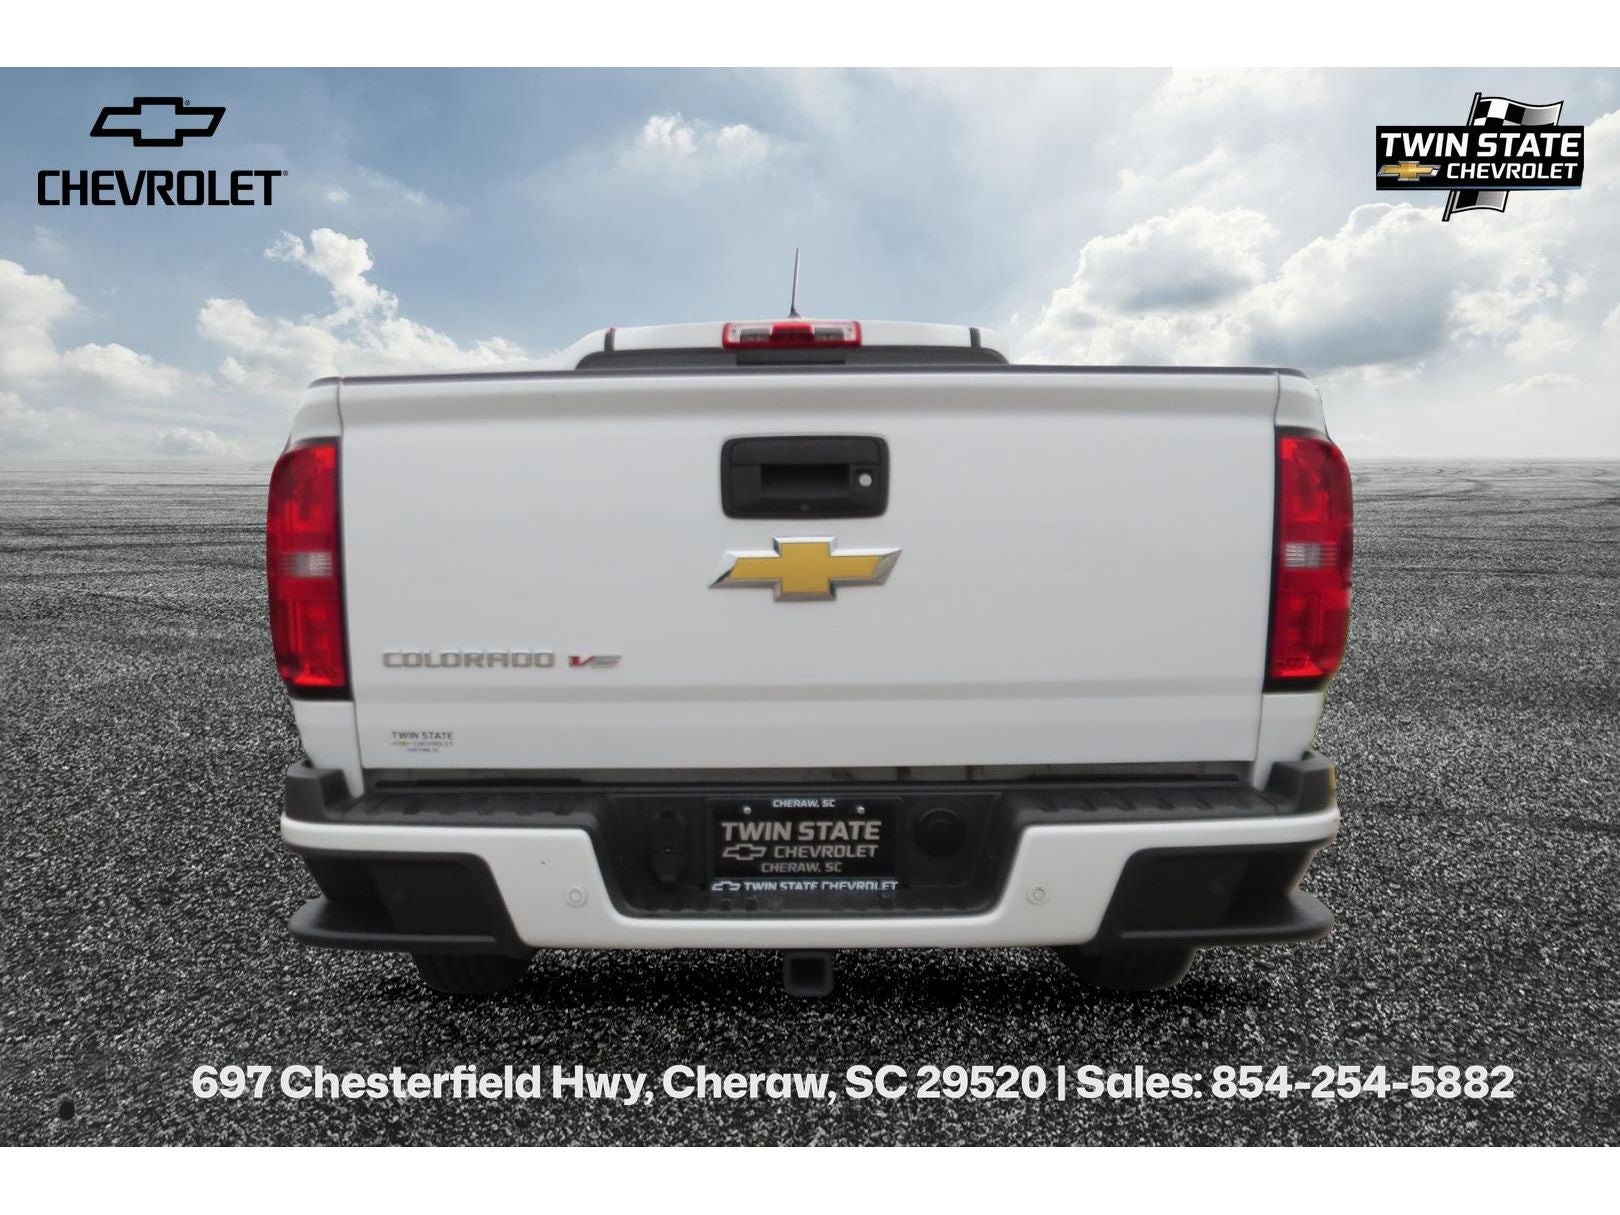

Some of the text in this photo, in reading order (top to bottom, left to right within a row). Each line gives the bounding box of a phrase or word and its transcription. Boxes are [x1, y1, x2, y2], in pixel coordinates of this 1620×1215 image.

[383, 652, 622, 668] COLORADO V6
[391, 731, 454, 740] TWIN STATE
[822, 799, 836, 808] SC
[721, 821, 882, 841] TWIN STATE
[773, 845, 879, 858] CHEVROLET
[825, 861, 842, 872] SC
[743, 881, 777, 890] TWIN
[780, 881, 818, 890] STATE
